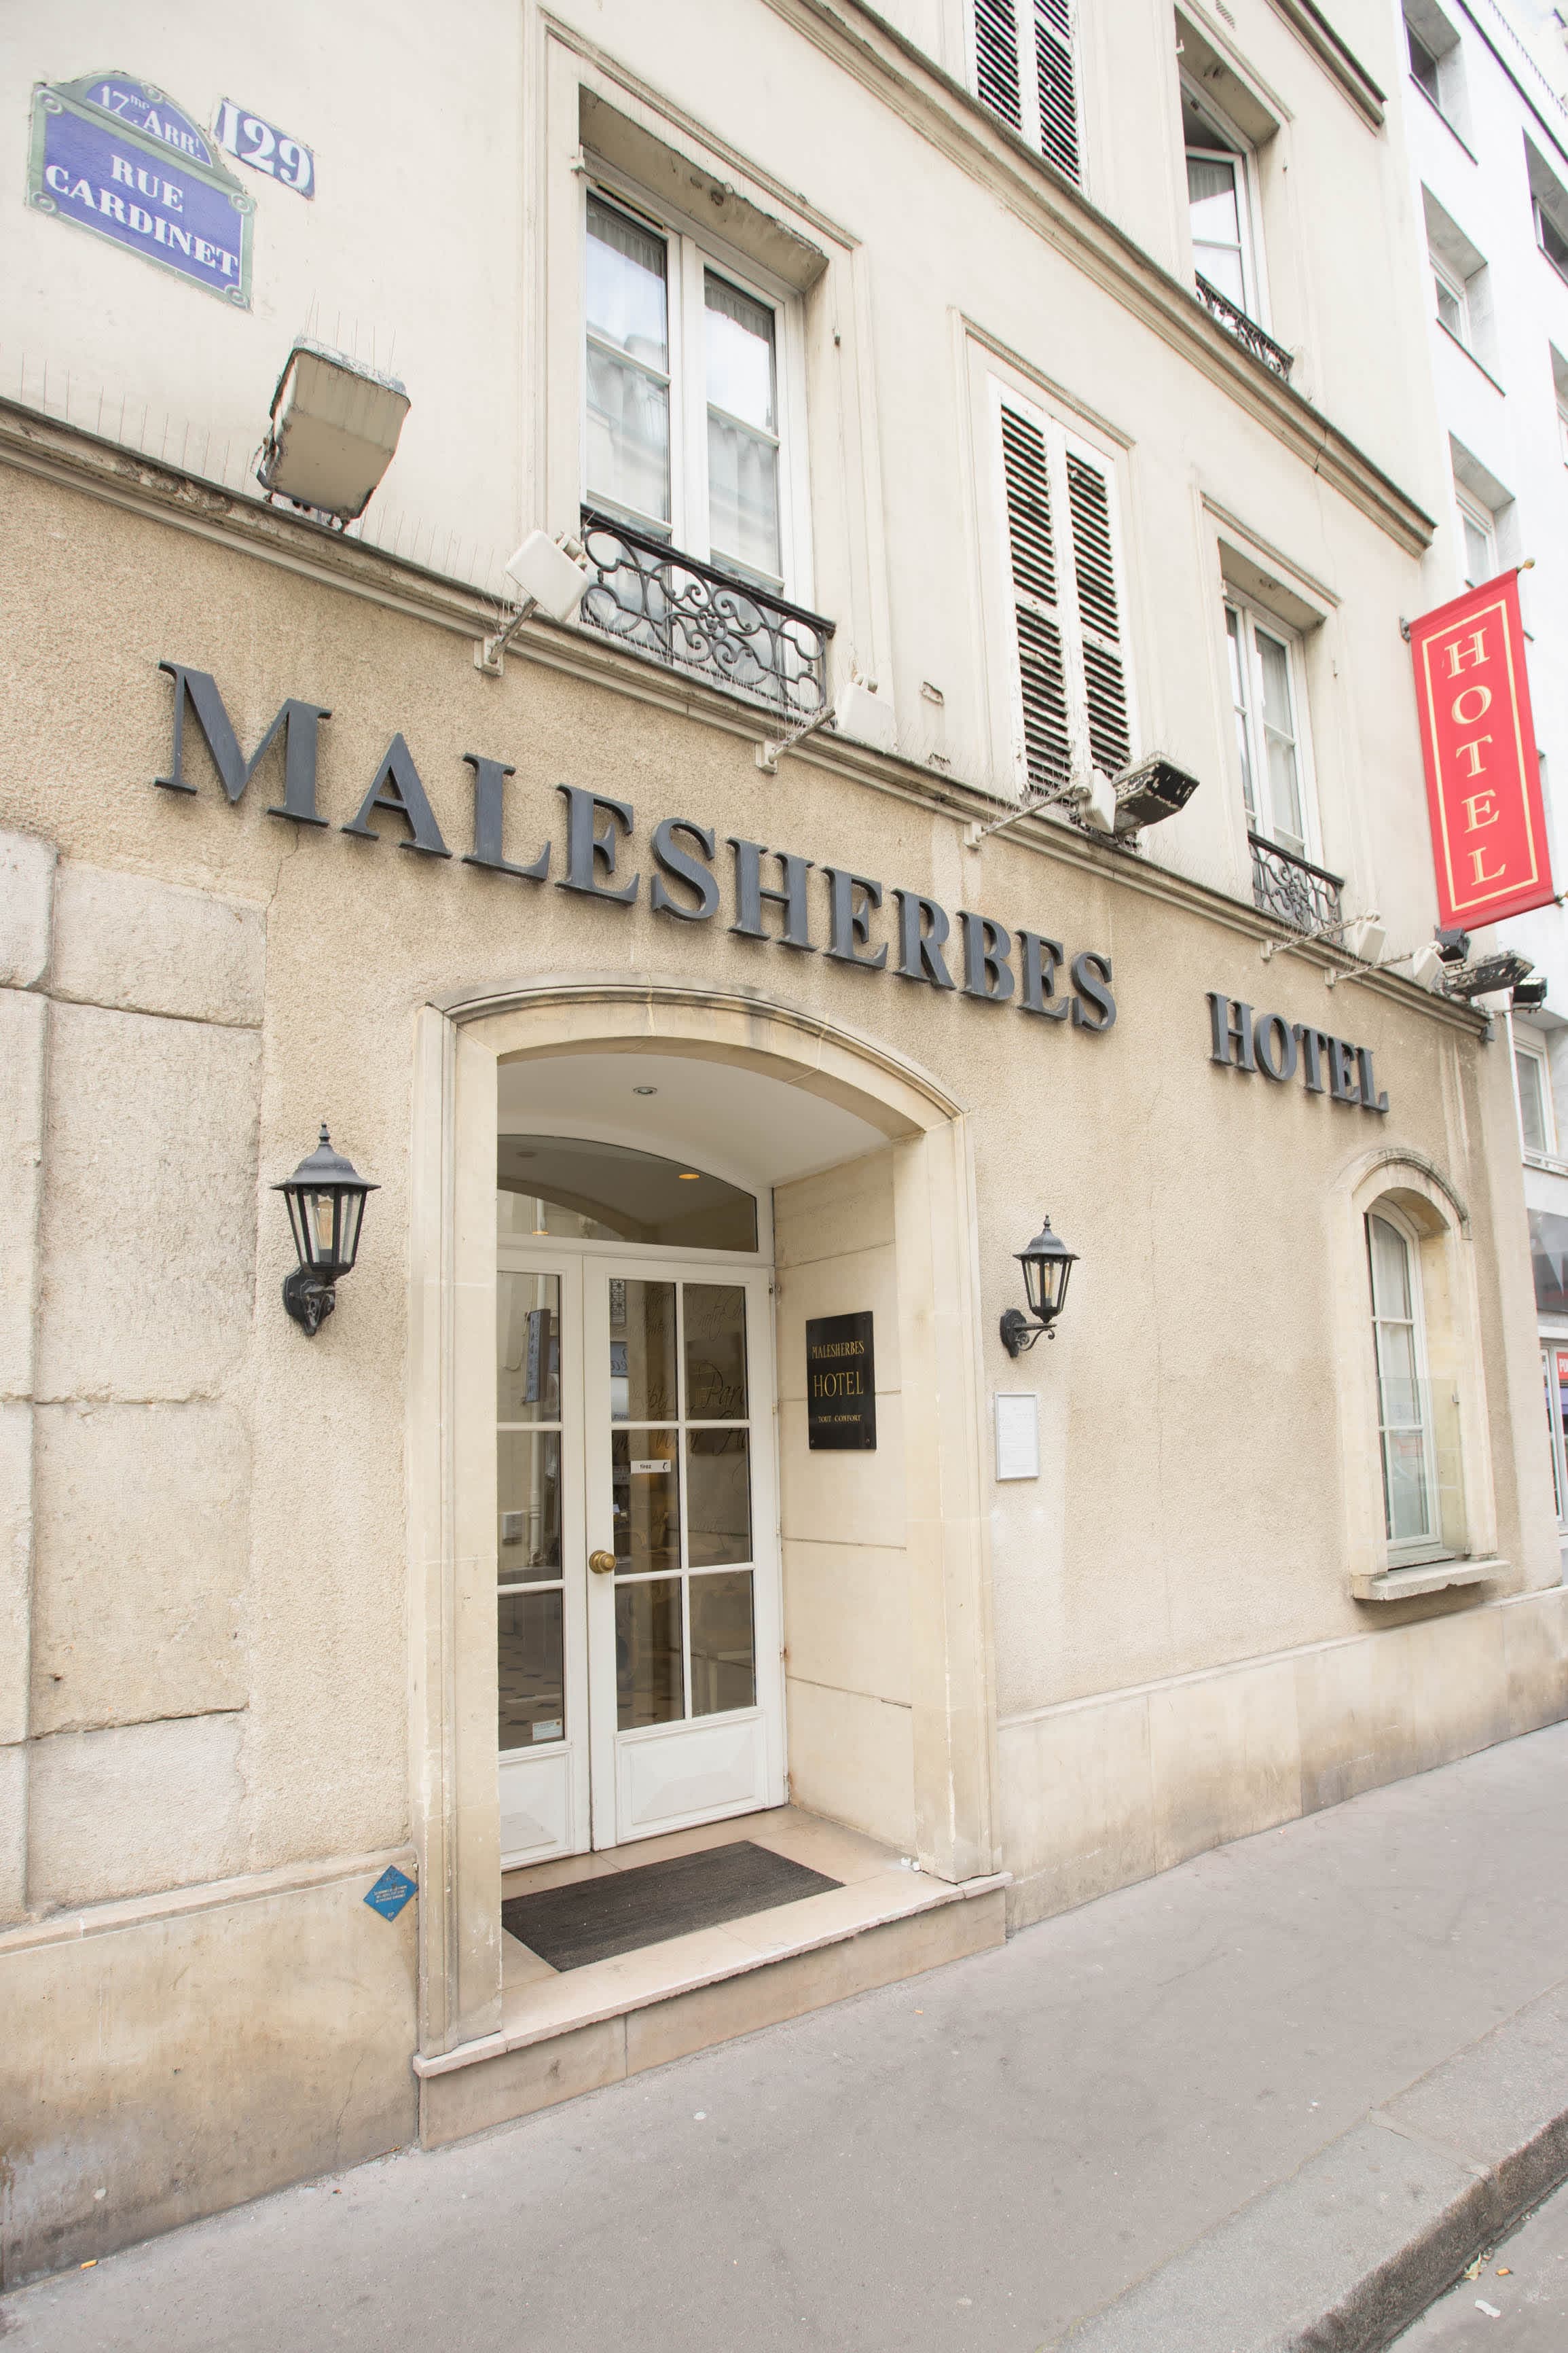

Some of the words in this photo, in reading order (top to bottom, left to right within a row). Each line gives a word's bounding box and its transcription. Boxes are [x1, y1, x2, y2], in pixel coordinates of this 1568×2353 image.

[221, 100, 311, 187] 129
[110, 154, 184, 213] RUE
[45, 164, 239, 277] CARDINET
[1444, 627, 1507, 886] HOTEL
[153, 660, 1118, 1032] MALESHERBES
[1205, 990, 1389, 1114] HOTEL
[812, 1340, 864, 1359] MALESHERBES
[814, 1370, 864, 1397] HOTEL
[818, 1415, 832, 1423] TOUT
[834, 1414, 862, 1422] CONFORT
